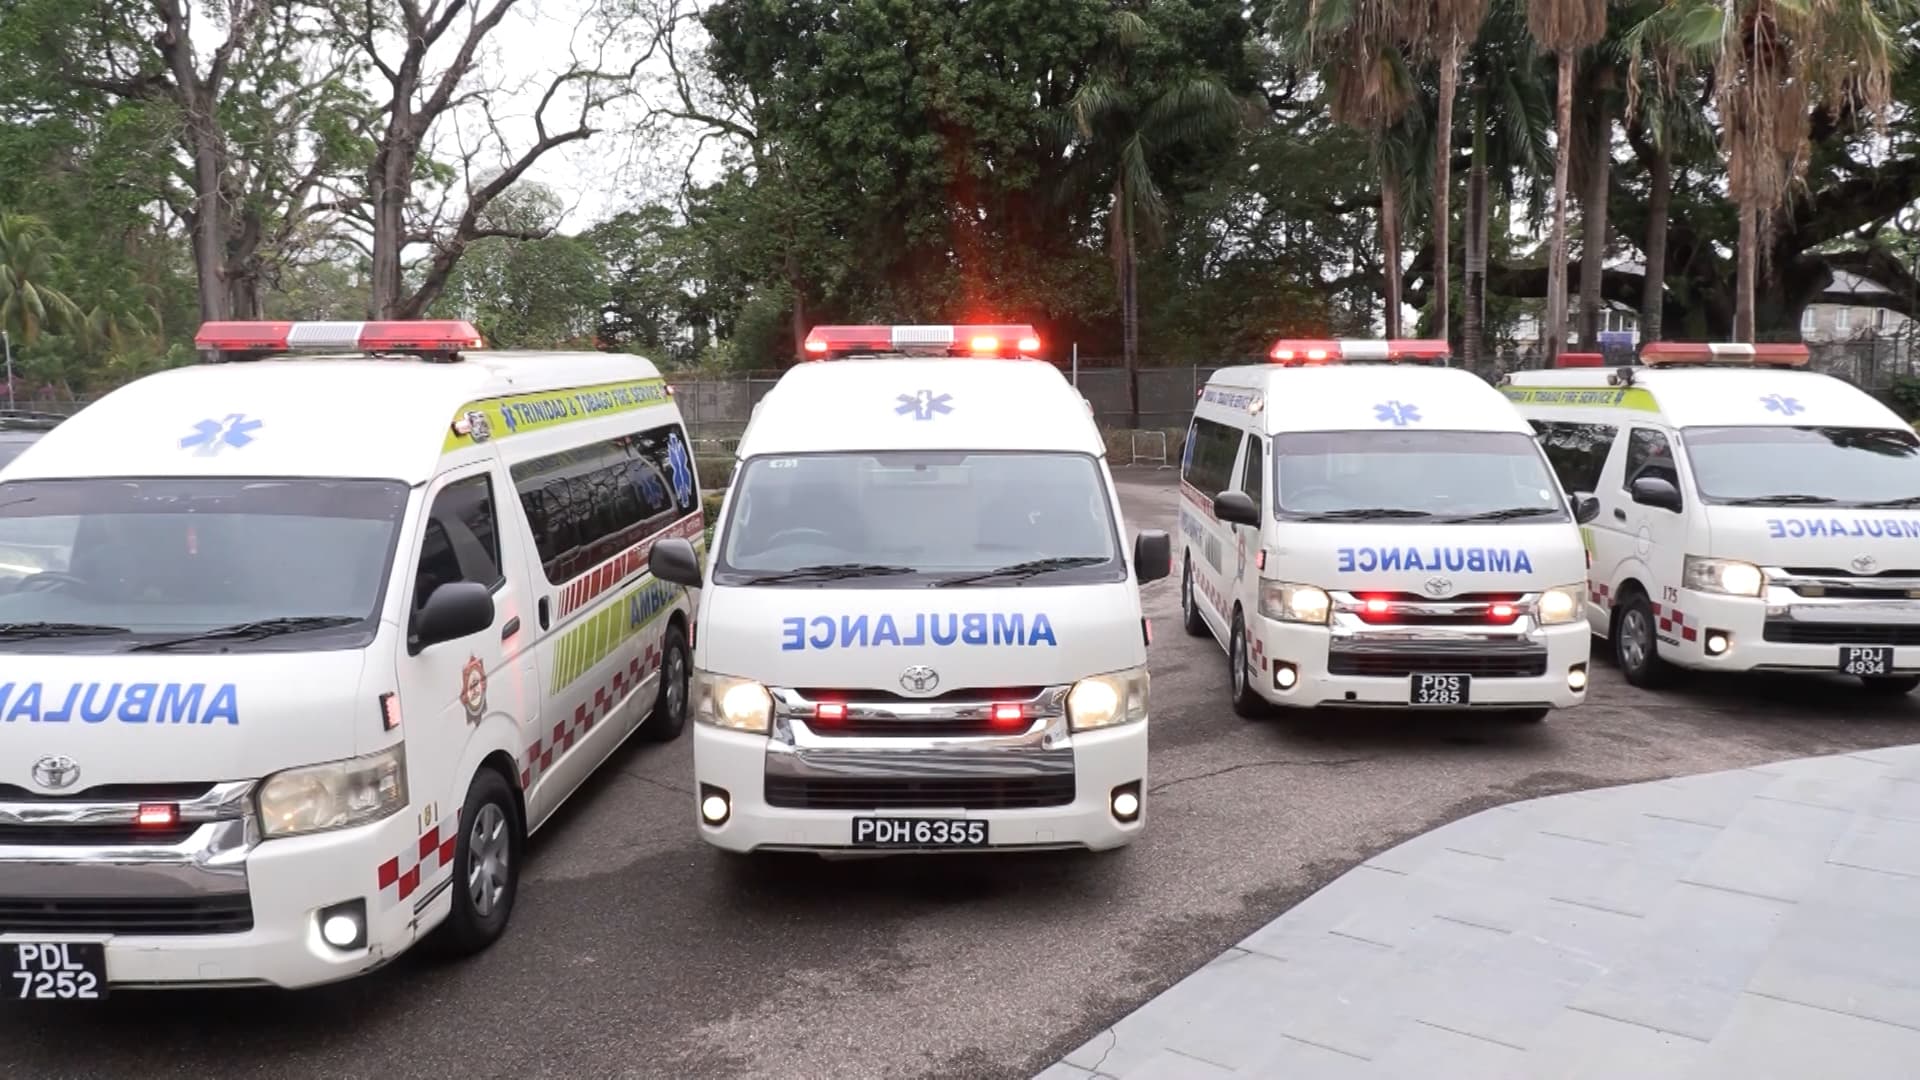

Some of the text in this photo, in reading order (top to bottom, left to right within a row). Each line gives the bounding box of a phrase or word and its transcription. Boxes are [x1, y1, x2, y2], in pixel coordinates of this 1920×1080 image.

[513, 399, 568, 425] TRINIDAD
[575, 391, 615, 414] TOBAGO
[1850, 648, 1883, 662] PDJ
[1844, 661, 1884, 674] 4934
[1421, 675, 1460, 691] PDS
[1418, 689, 1460, 704] 3285
[19, 943, 84, 971] PDL
[12, 970, 99, 999] 7252
